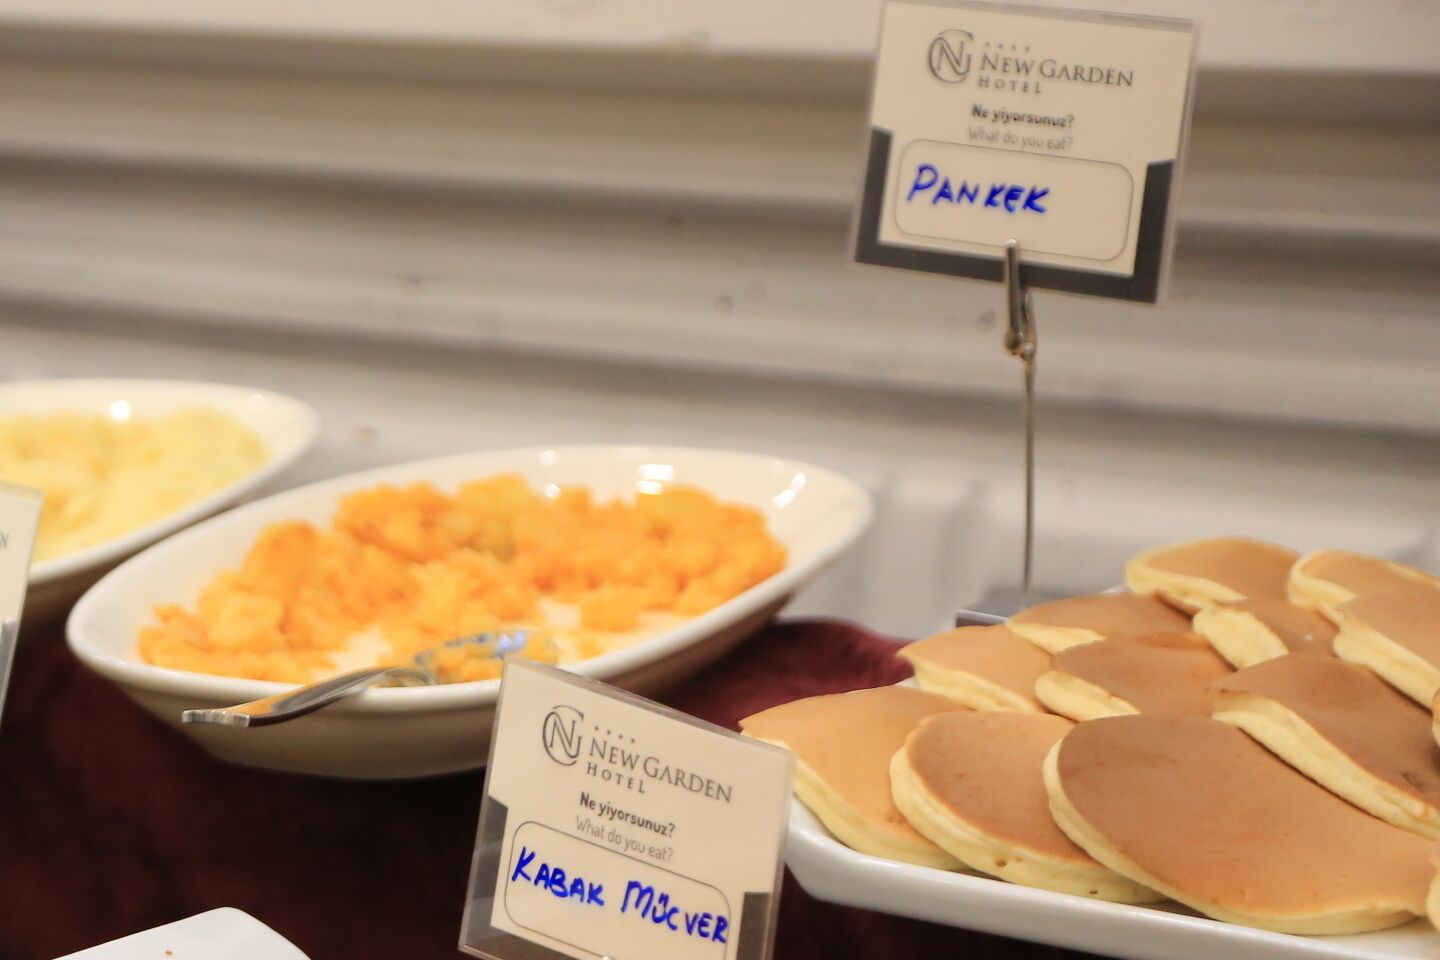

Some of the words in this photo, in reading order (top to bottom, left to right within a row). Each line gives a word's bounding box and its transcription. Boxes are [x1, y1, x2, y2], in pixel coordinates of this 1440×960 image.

[978, 76, 1041, 94] HOTEL
[968, 126, 999, 142] What
[971, 103, 989, 119] Ne
[992, 107, 1075, 128] yiyorsunuz?
[908, 163, 1051, 214] PANKEK
[586, 761, 646, 794] HOTEL
[580, 791, 596, 810] Ne
[597, 801, 676, 838] yiyorsunuz?
[576, 815, 605, 840] What
[607, 828, 622, 845] do
[625, 837, 645, 854] you
[648, 844, 674, 863] eat?
[511, 846, 605, 906] KABAK
